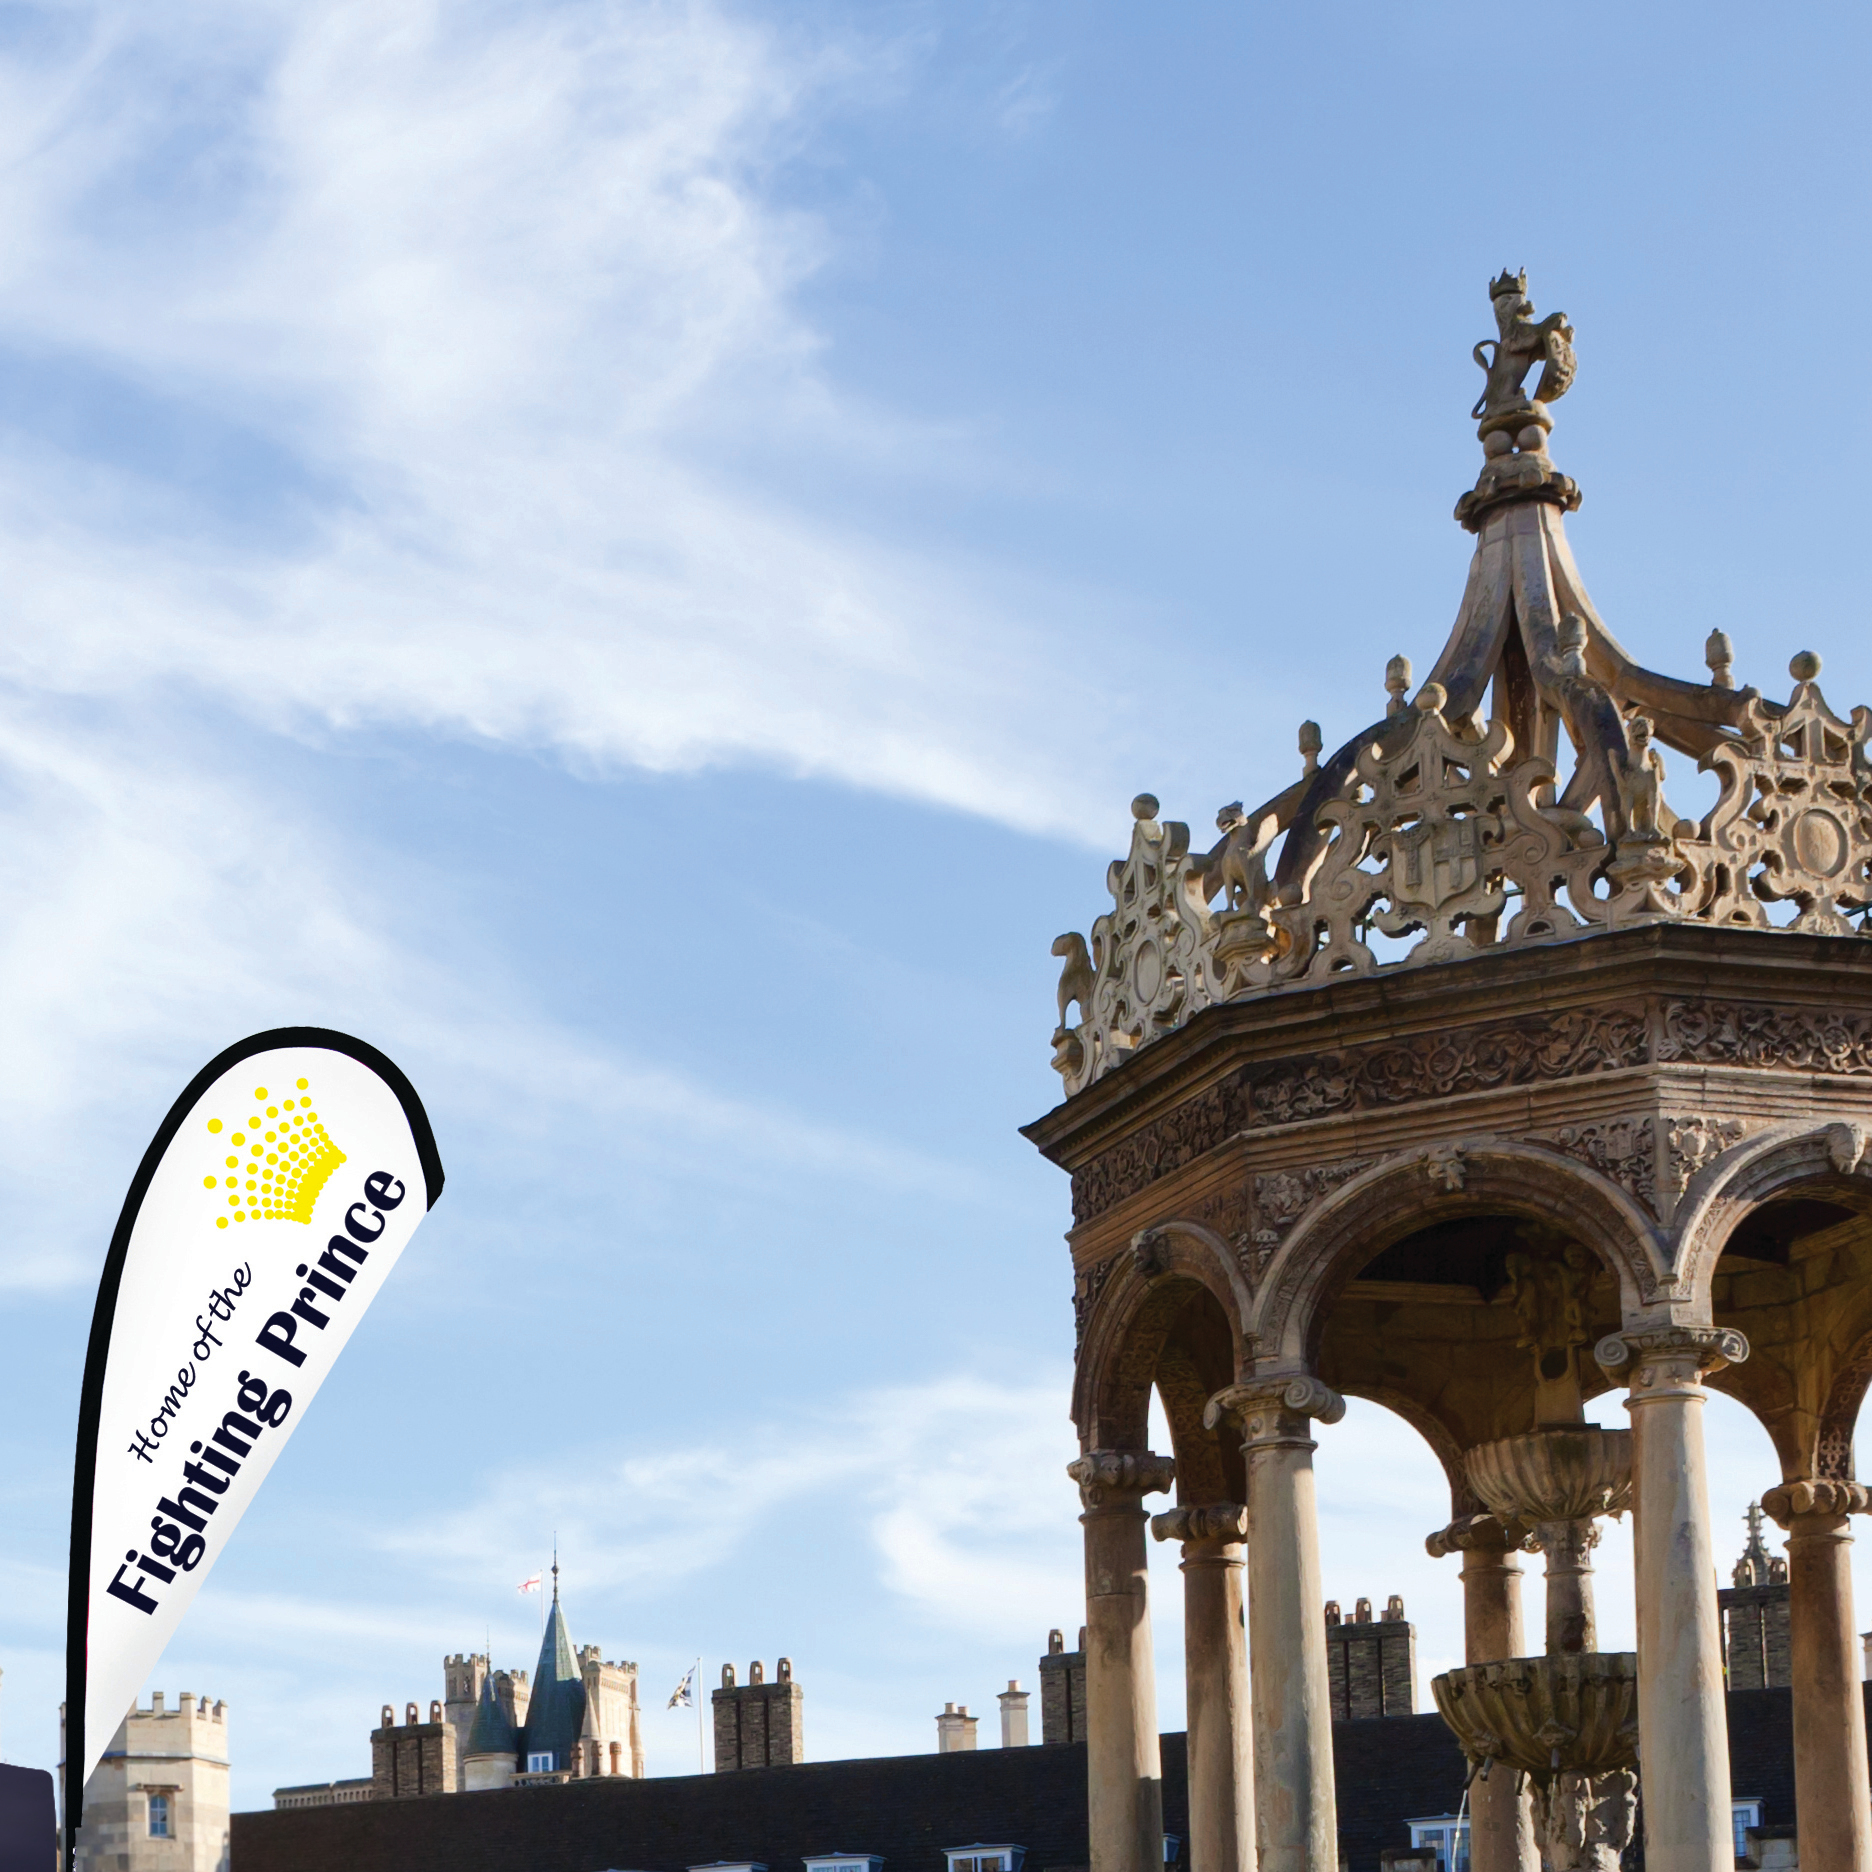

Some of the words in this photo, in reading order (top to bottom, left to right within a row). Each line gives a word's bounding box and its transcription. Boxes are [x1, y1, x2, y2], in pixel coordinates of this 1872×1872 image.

[105, 1369, 293, 1617] Fighting
[254, 1169, 407, 1369] Prince
[127, 1361, 196, 1464] Home
[193, 1314, 223, 1362] of
[208, 1261, 252, 1322] the
